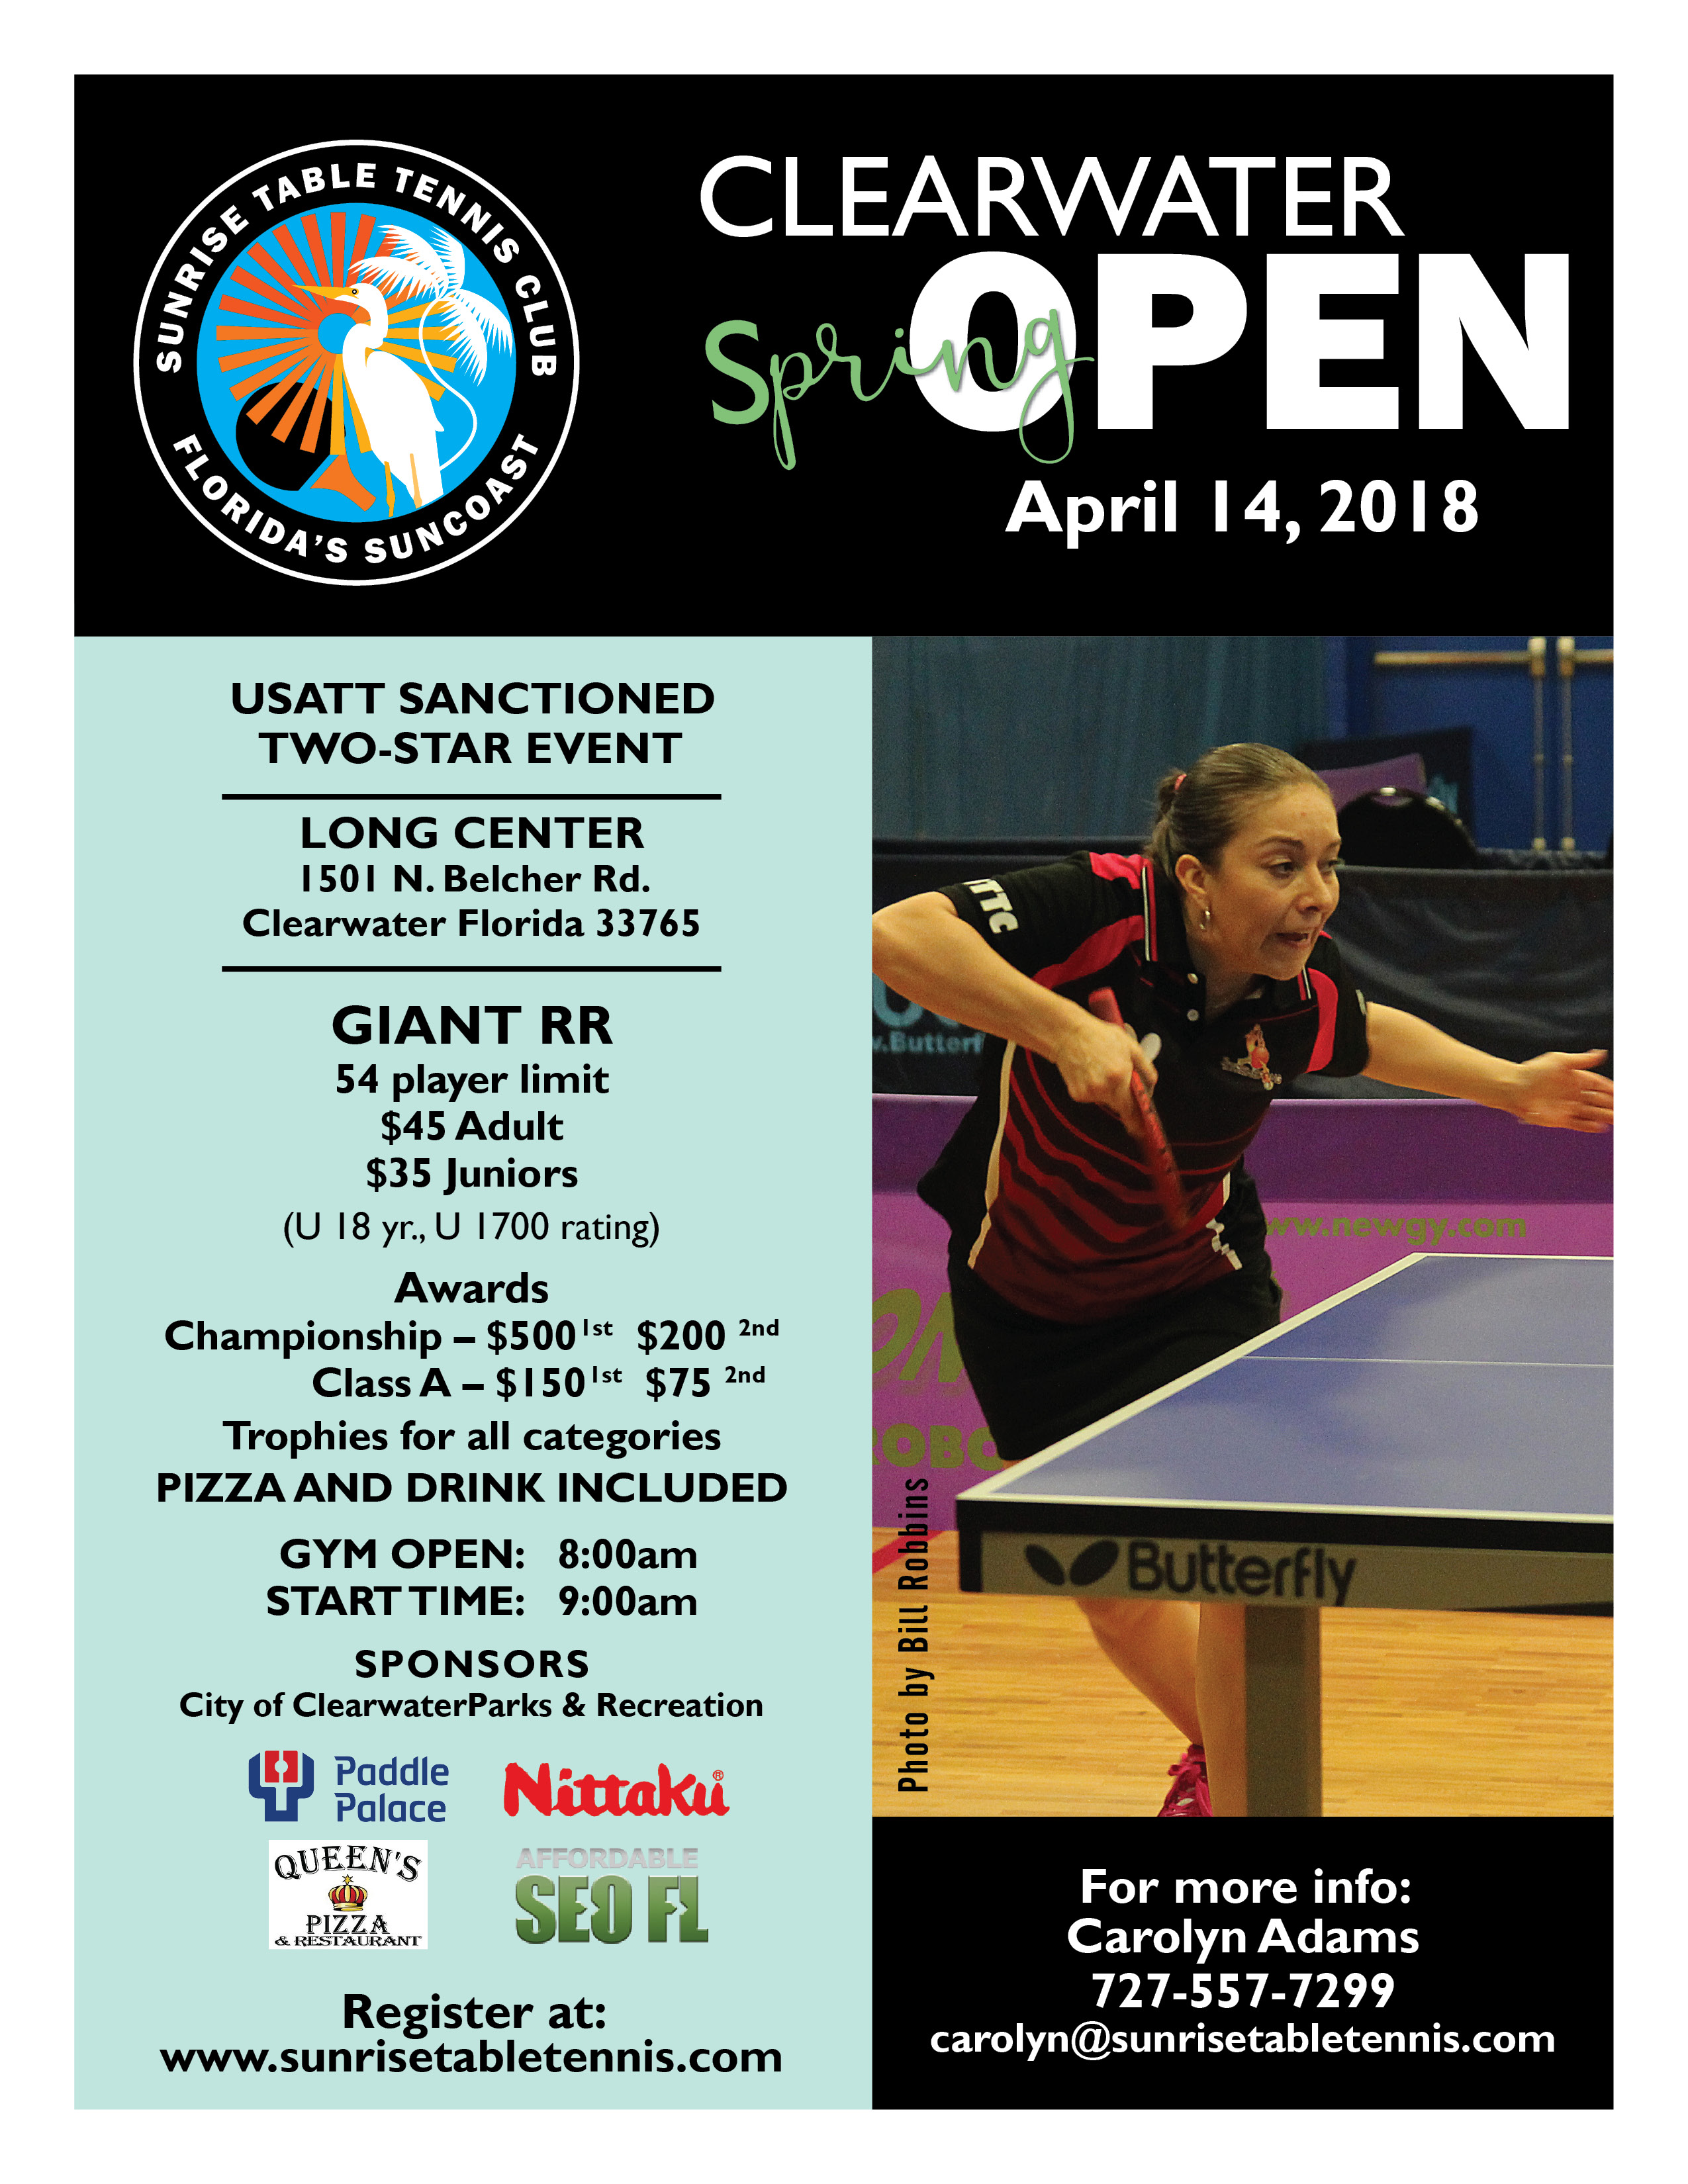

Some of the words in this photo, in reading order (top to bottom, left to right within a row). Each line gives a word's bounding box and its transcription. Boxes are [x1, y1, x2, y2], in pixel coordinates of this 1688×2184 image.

[701, 156, 1405, 237] CLEARWATER
[157, 205, 249, 373] SUNRISE
[252, 163, 376, 211] TABLE
[397, 167, 519, 263] TENNIS
[516, 275, 556, 376] CLUB
[910, 251, 1569, 432] OPEN
[706, 309, 1094, 470] Spring
[173, 434, 347, 563] FLORIDA’S
[365, 434, 538, 563] SUNCOAST
[1006, 480, 1176, 549] April
[1215, 480, 1300, 544] 14,
[1321, 480, 1477, 532] 2018
[233, 682, 385, 714] USATT
[400, 682, 714, 714] SANCTIONED
[259, 732, 512, 764] TWO-STAR
[528, 733, 682, 764] EVENT
[303, 817, 437, 848] LONG
[455, 817, 644, 848] CENTER
[303, 864, 373, 892] 1501
[395, 865, 434, 892] N.
[445, 865, 581, 892] Belcher
[594, 865, 649, 892] Rd.
[244, 909, 446, 936] Clearwater
[459, 909, 585, 936] Florida
[597, 909, 699, 936] 33765
[961, 878, 1019, 934] TTC
[333, 1005, 521, 1044] GIANT
[542, 1006, 613, 1044] RR
[337, 1064, 378, 1093] 54
[394, 1064, 508, 1102] player
[522, 1064, 609, 1093] limit
[382, 1111, 445, 1145] $45
[455, 1111, 563, 1140] Adult
[367, 1158, 430, 1195] $35
[444, 1158, 577, 1195] Juniors
[285, 1212, 320, 1248] (U
[340, 1212, 369, 1240] 18
[382, 1221, 425, 1248] yr.,
[436, 1212, 459, 1240] U
[480, 1212, 548, 1240] 1700
[563, 1212, 659, 1248] rating)
[394, 1272, 548, 1303] Awards
[165, 1320, 442, 1359] Championship
[638, 1319, 725, 1356] $200
[739, 1319, 778, 1336] 2nd
[313, 1367, 410, 1397] Class
[419, 1368, 451, 1396] A
[647, 1367, 710, 1402] $75
[726, 1366, 765, 1383] 2nd
[223, 1420, 387, 1459] Trophies
[400, 1420, 455, 1450] for
[468, 1421, 508, 1450] all
[524, 1420, 720, 1459] categories
[158, 1473, 286, 1502] PIZZA
[293, 1473, 392, 1502] AND
[408, 1473, 545, 1502] DRINK
[559, 1473, 787, 1502] INCLUDED
[281, 1539, 375, 1569] GYM
[392, 1539, 524, 1569] OPEN:
[559, 1539, 696, 1569] 8:00am
[1127, 1540, 1357, 1607] Butterfly
[267, 1586, 402, 1615] START
[409, 1586, 524, 1615] TIME:
[559, 1586, 696, 1615] 9:00am
[356, 1650, 588, 1678] SPONSORS
[180, 1692, 244, 1724] City
[254, 1692, 285, 1717] of
[563, 1692, 585, 1717] &
[598, 1692, 762, 1717] Recreation
[334, 1756, 449, 1786] Paddle
[334, 1793, 445, 1822] Palace
[275, 1845, 422, 1882] QUEEN'S
[516, 1848, 698, 1868] AFFORDABLE
[1083, 1869, 1159, 1903] For
[1176, 1879, 1297, 1903] more
[1315, 1868, 1409, 1903] info:
[306, 1915, 390, 1934] PIZZA
[516, 1875, 632, 1944] SEO
[648, 1875, 708, 1943] FL
[275, 1936, 290, 1946] &
[294, 1936, 422, 1947] RESTAURANT
[1068, 1918, 1245, 1964] Carolyn
[1258, 1919, 1419, 1953] Adams
[1093, 1973, 1393, 2008] 727-557-7299
[345, 1993, 534, 2038] Register
[549, 1997, 605, 2026] at:
[160, 2038, 781, 2072] www.sunrisetabletennis.com
[931, 2021, 1554, 2061] carolyn@sunrisetabletennis.com
